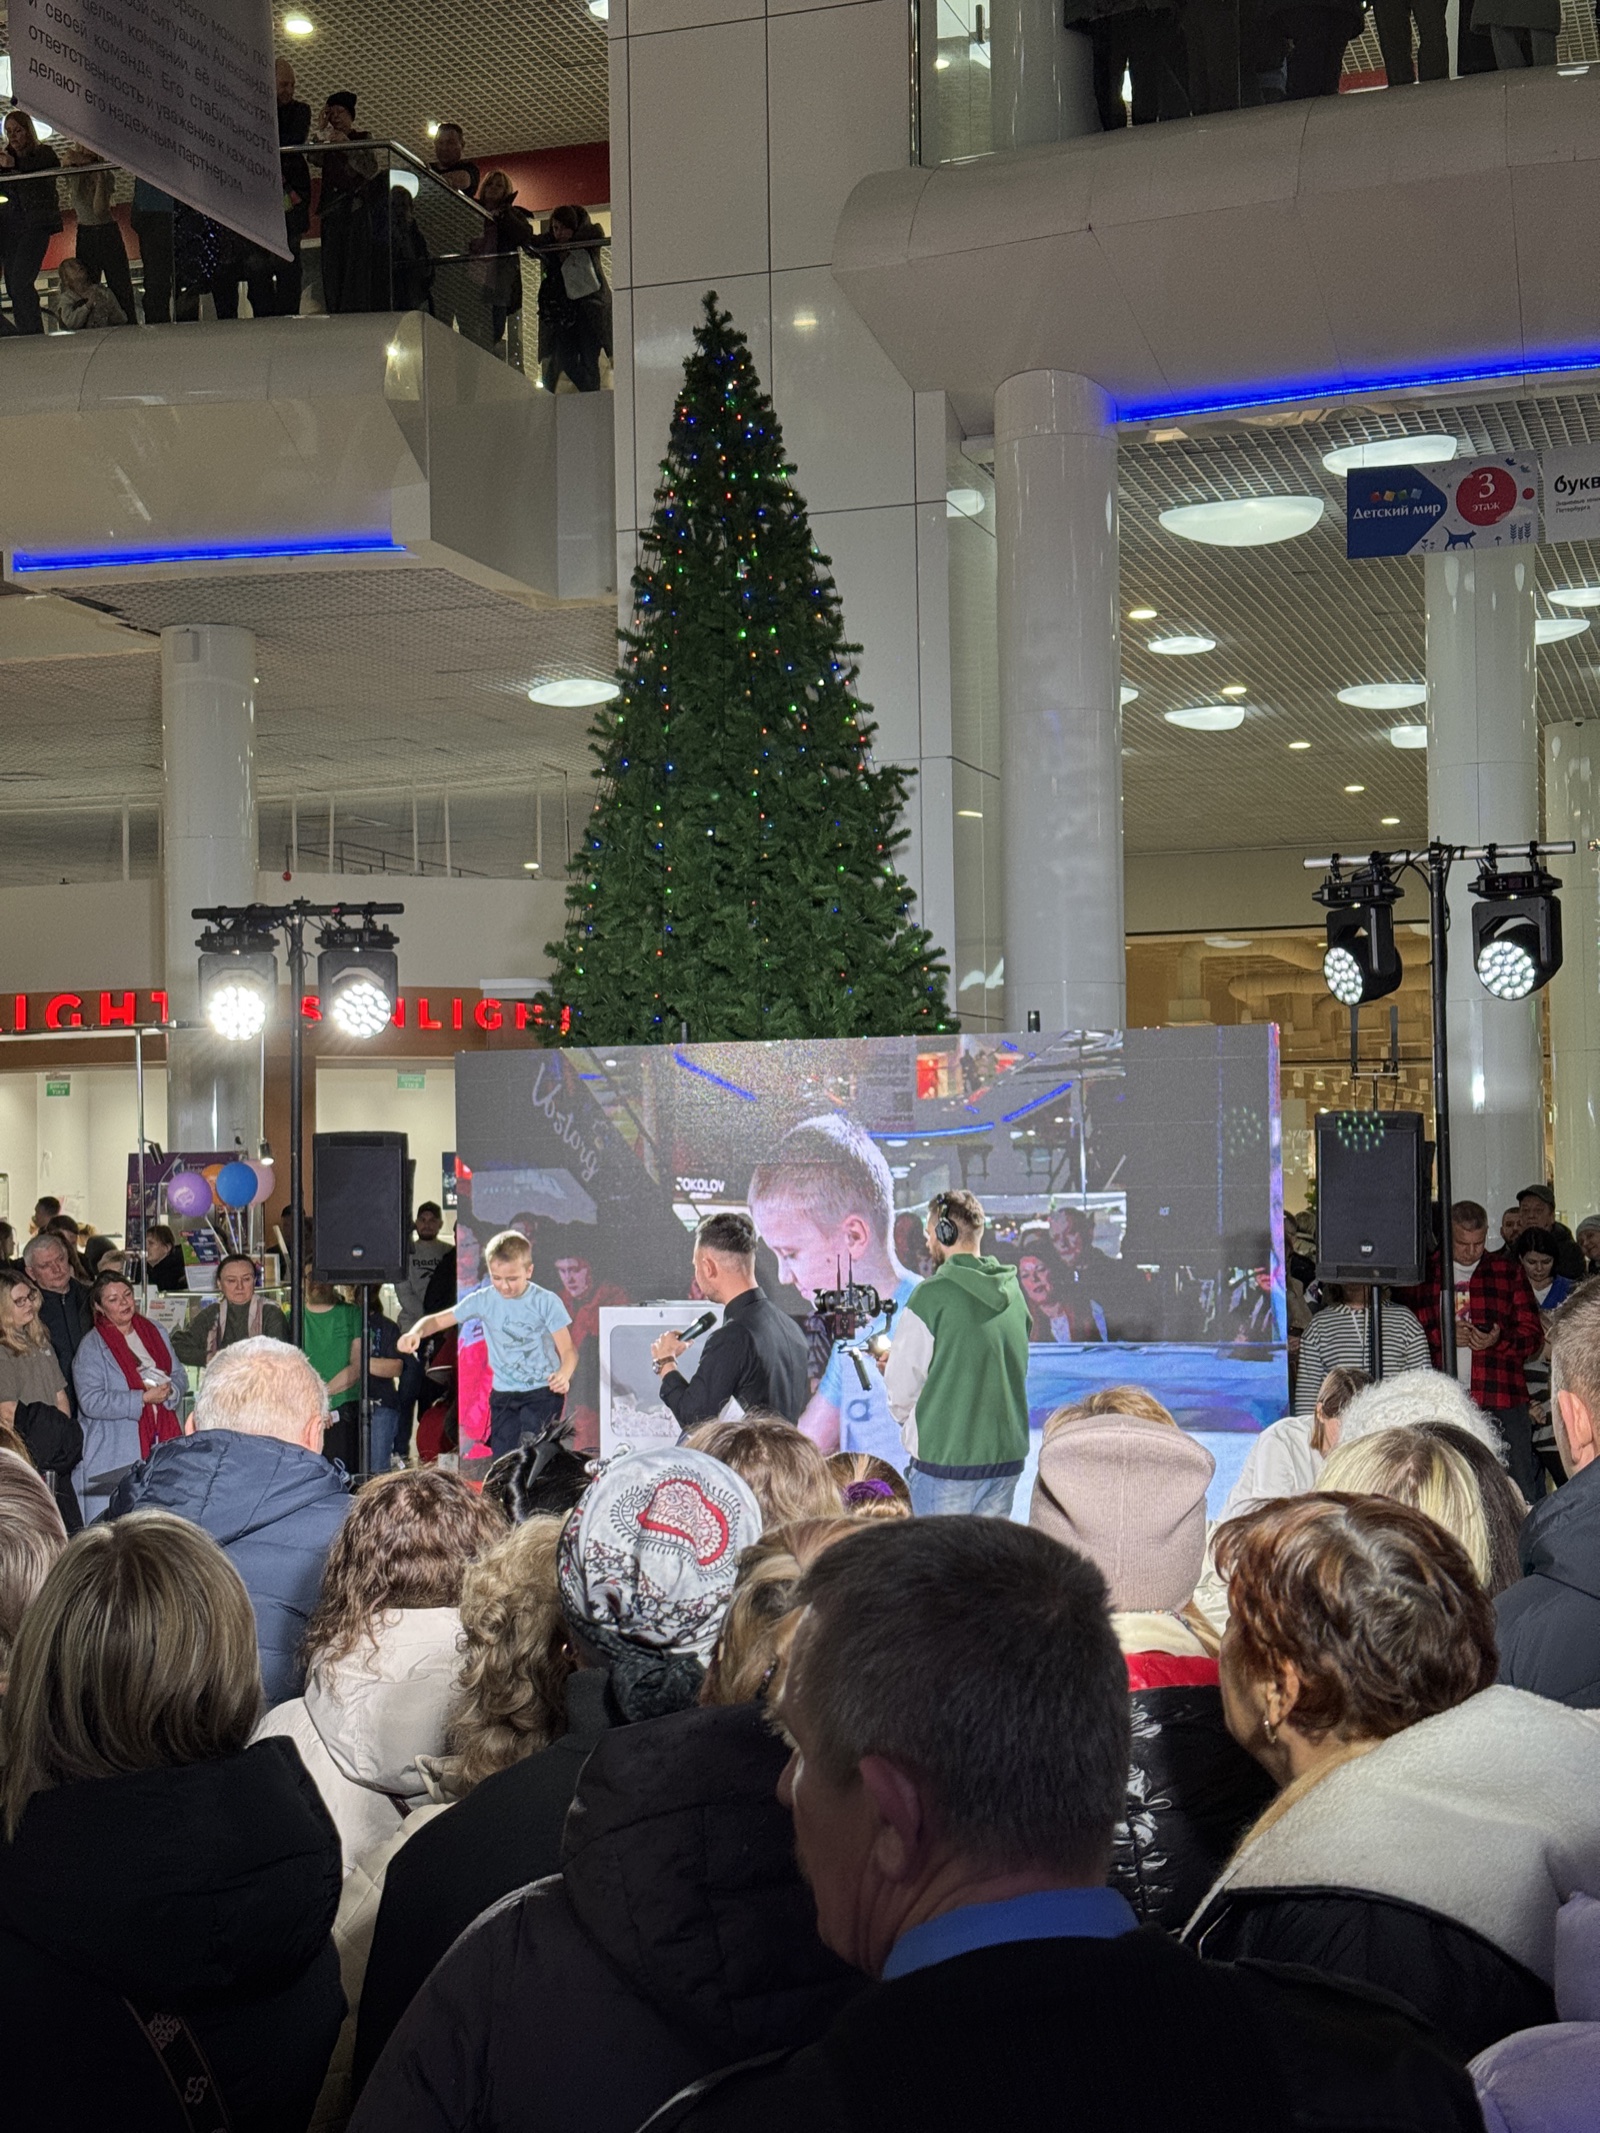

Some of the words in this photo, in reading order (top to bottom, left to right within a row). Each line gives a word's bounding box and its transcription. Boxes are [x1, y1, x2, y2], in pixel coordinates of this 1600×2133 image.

[46, 3, 88, 41] своей
[162, 71, 184, 99] Его
[29, 57, 82, 98] делают
[85, 89, 106, 113] его
[29, 25, 144, 105] ответственность
[146, 95, 154, 111] и
[155, 102, 216, 148] уважение
[218, 139, 226, 155] к
[1478, 473, 1496, 498] 3
[1554, 474, 1600, 497] букв
[1352, 505, 1409, 520] Детский
[1412, 502, 1441, 518] мир
[1471, 501, 1501, 513] этаж
[0, 992, 168, 1030] IGHT
